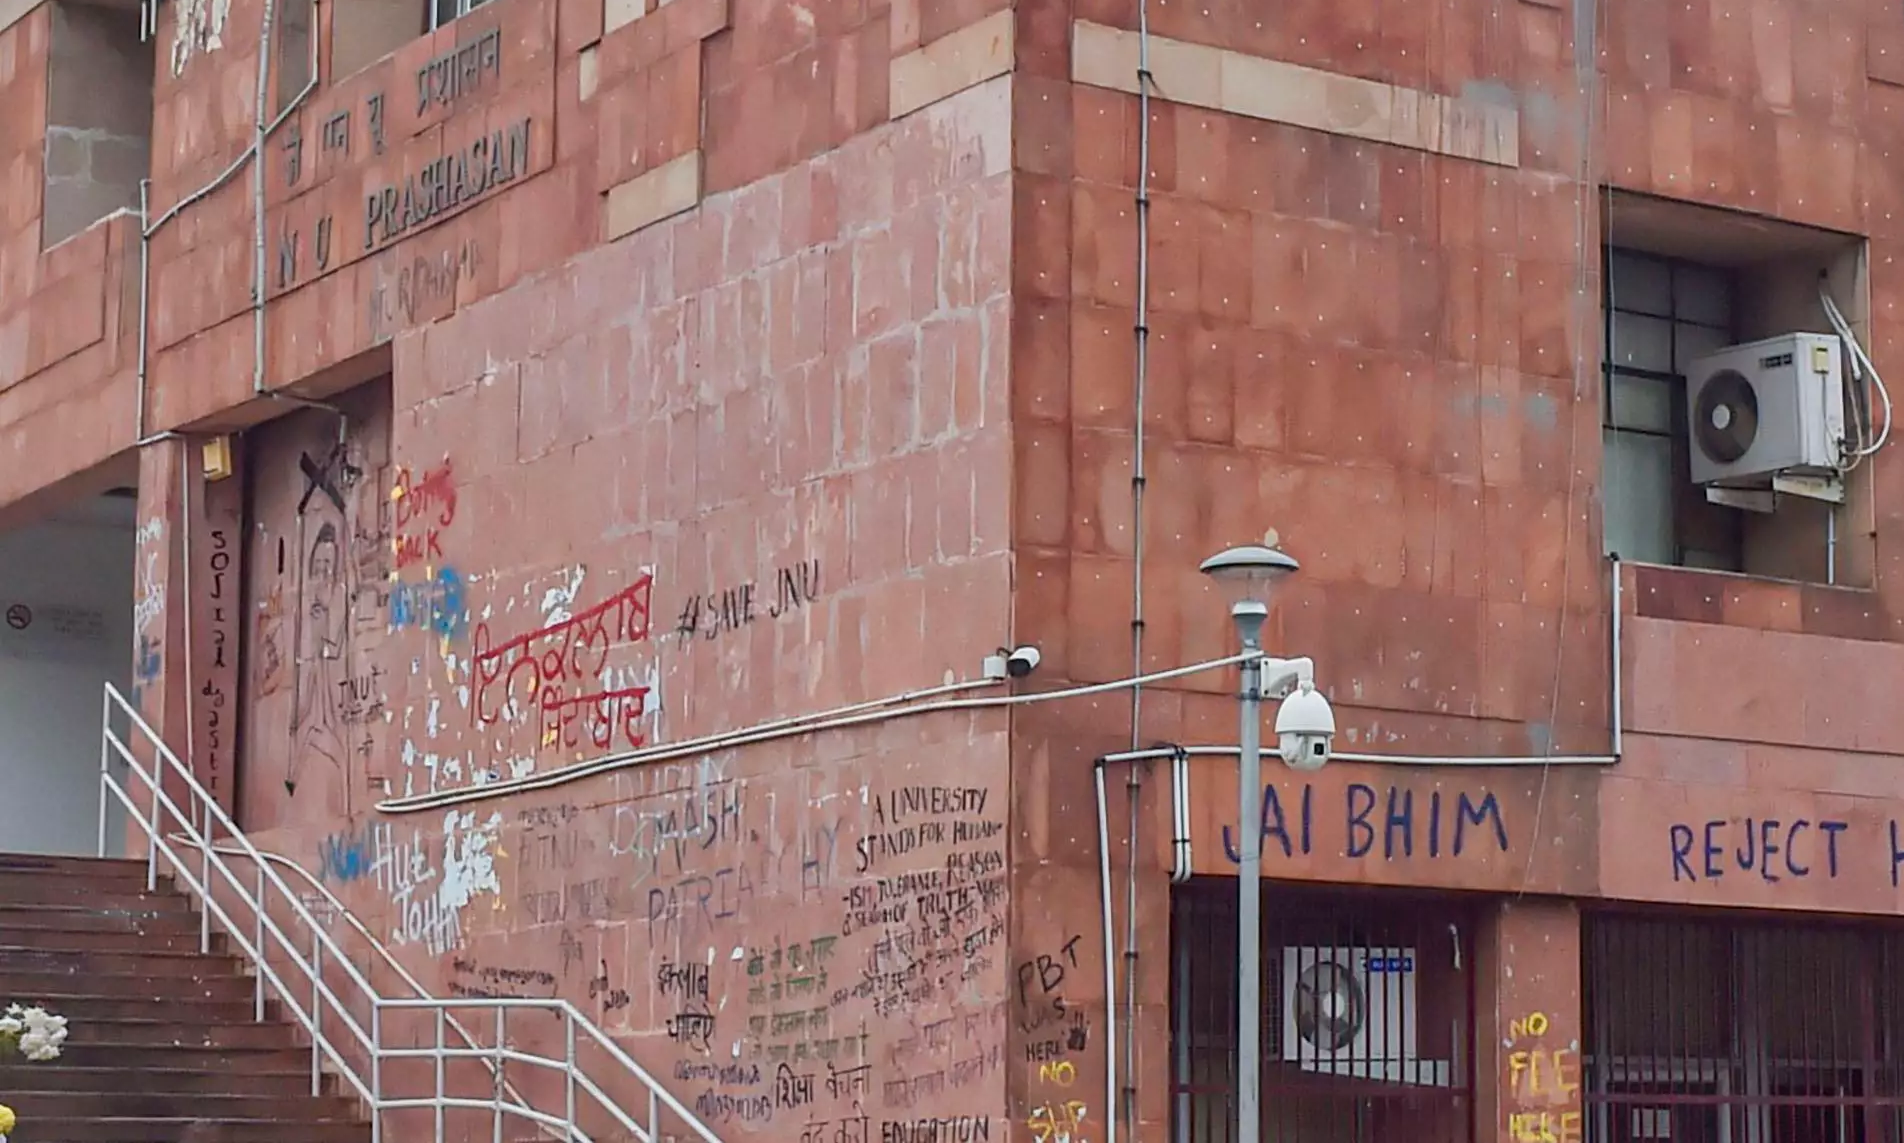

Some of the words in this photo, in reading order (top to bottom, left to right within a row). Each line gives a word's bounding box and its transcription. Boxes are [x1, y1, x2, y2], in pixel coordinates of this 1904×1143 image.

[364, 116, 532, 251] PRASHASAN
[770, 558, 820, 620] JNU
[890, 785, 988, 825] UNIVERSITY
[1346, 783, 1509, 860] BHIM
[1669, 818, 1850, 884] REJECT
[1017, 933, 1083, 1010] PBT
[1510, 1011, 1548, 1041] NO
